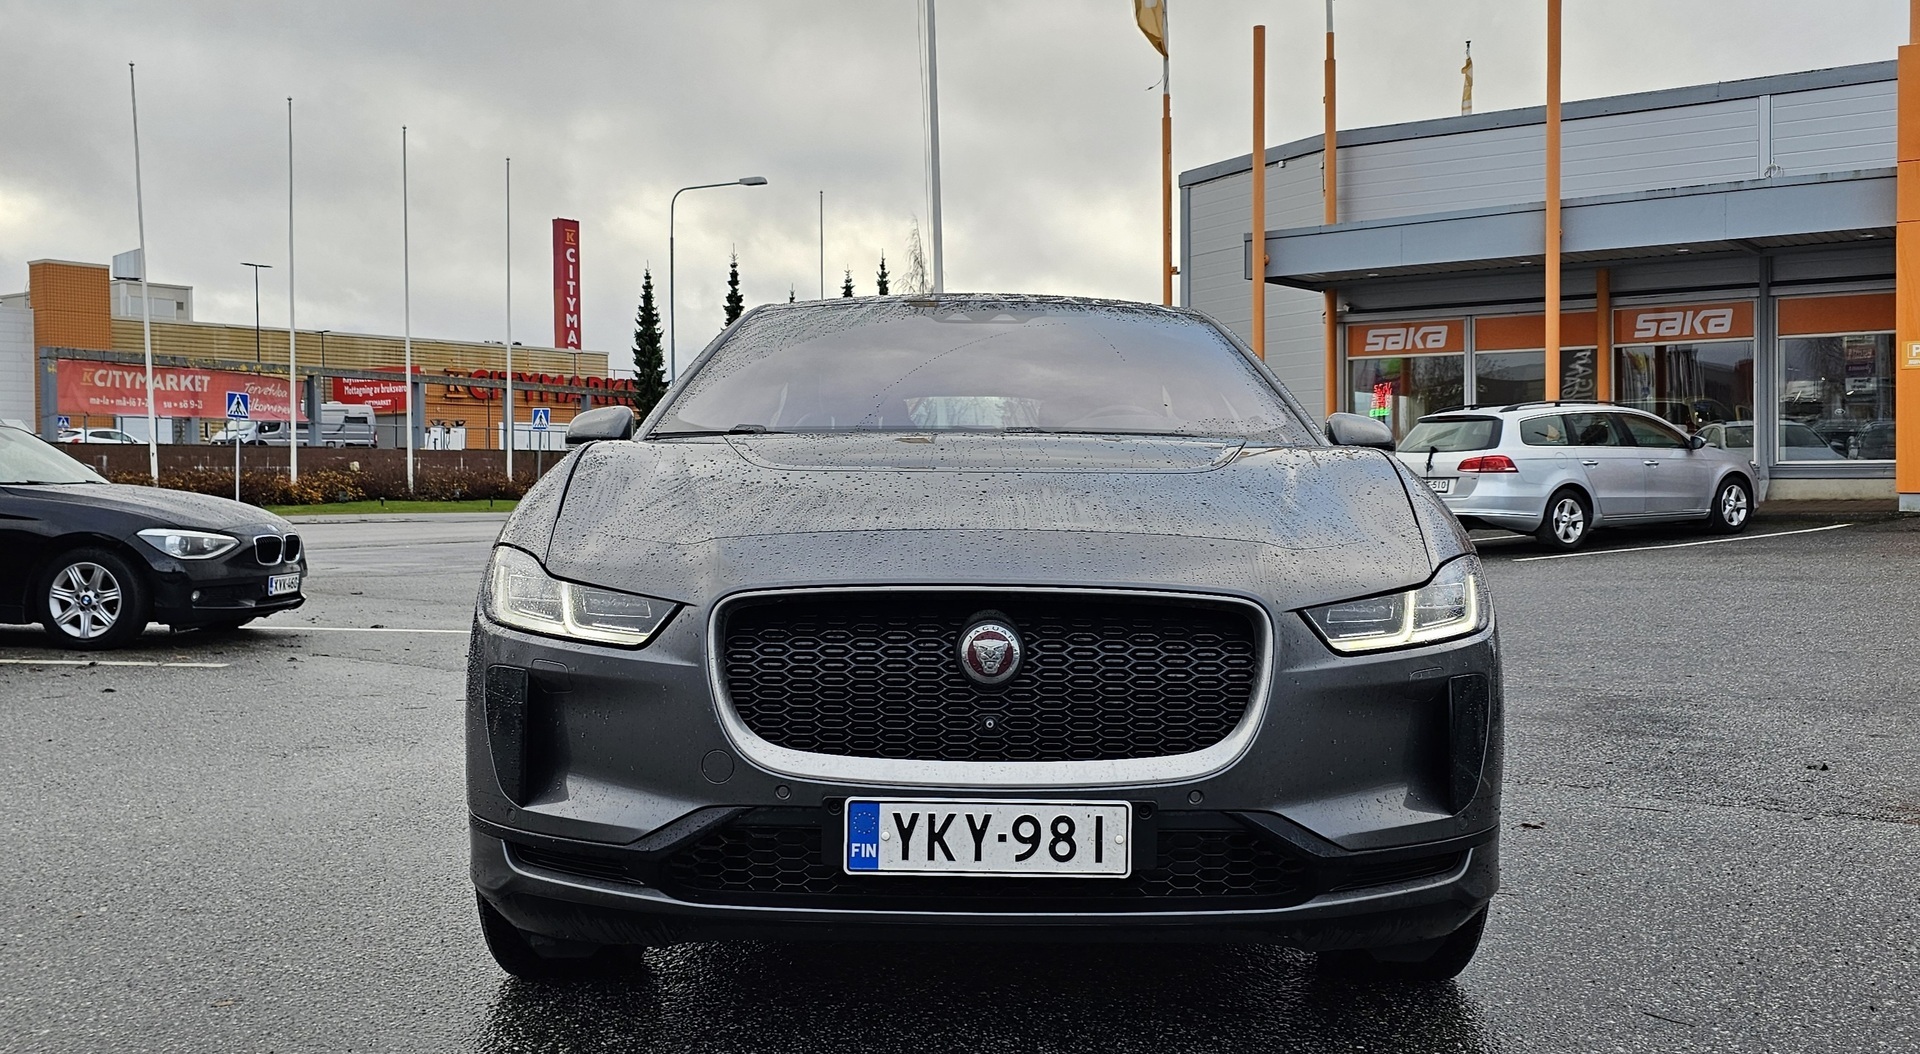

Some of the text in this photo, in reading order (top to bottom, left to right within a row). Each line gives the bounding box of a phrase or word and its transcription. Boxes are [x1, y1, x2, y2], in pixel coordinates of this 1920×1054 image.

[566, 248, 578, 349] CITYMA
[94, 369, 211, 392] CITYMARKET
[344, 383, 407, 397] Mottagning av bruksvaro
[138, 398, 149, 407] 7-2
[179, 400, 188, 408] sö
[968, 626, 1014, 642] JAGUAR
[851, 812, 1103, 863] FIN YKY-981
